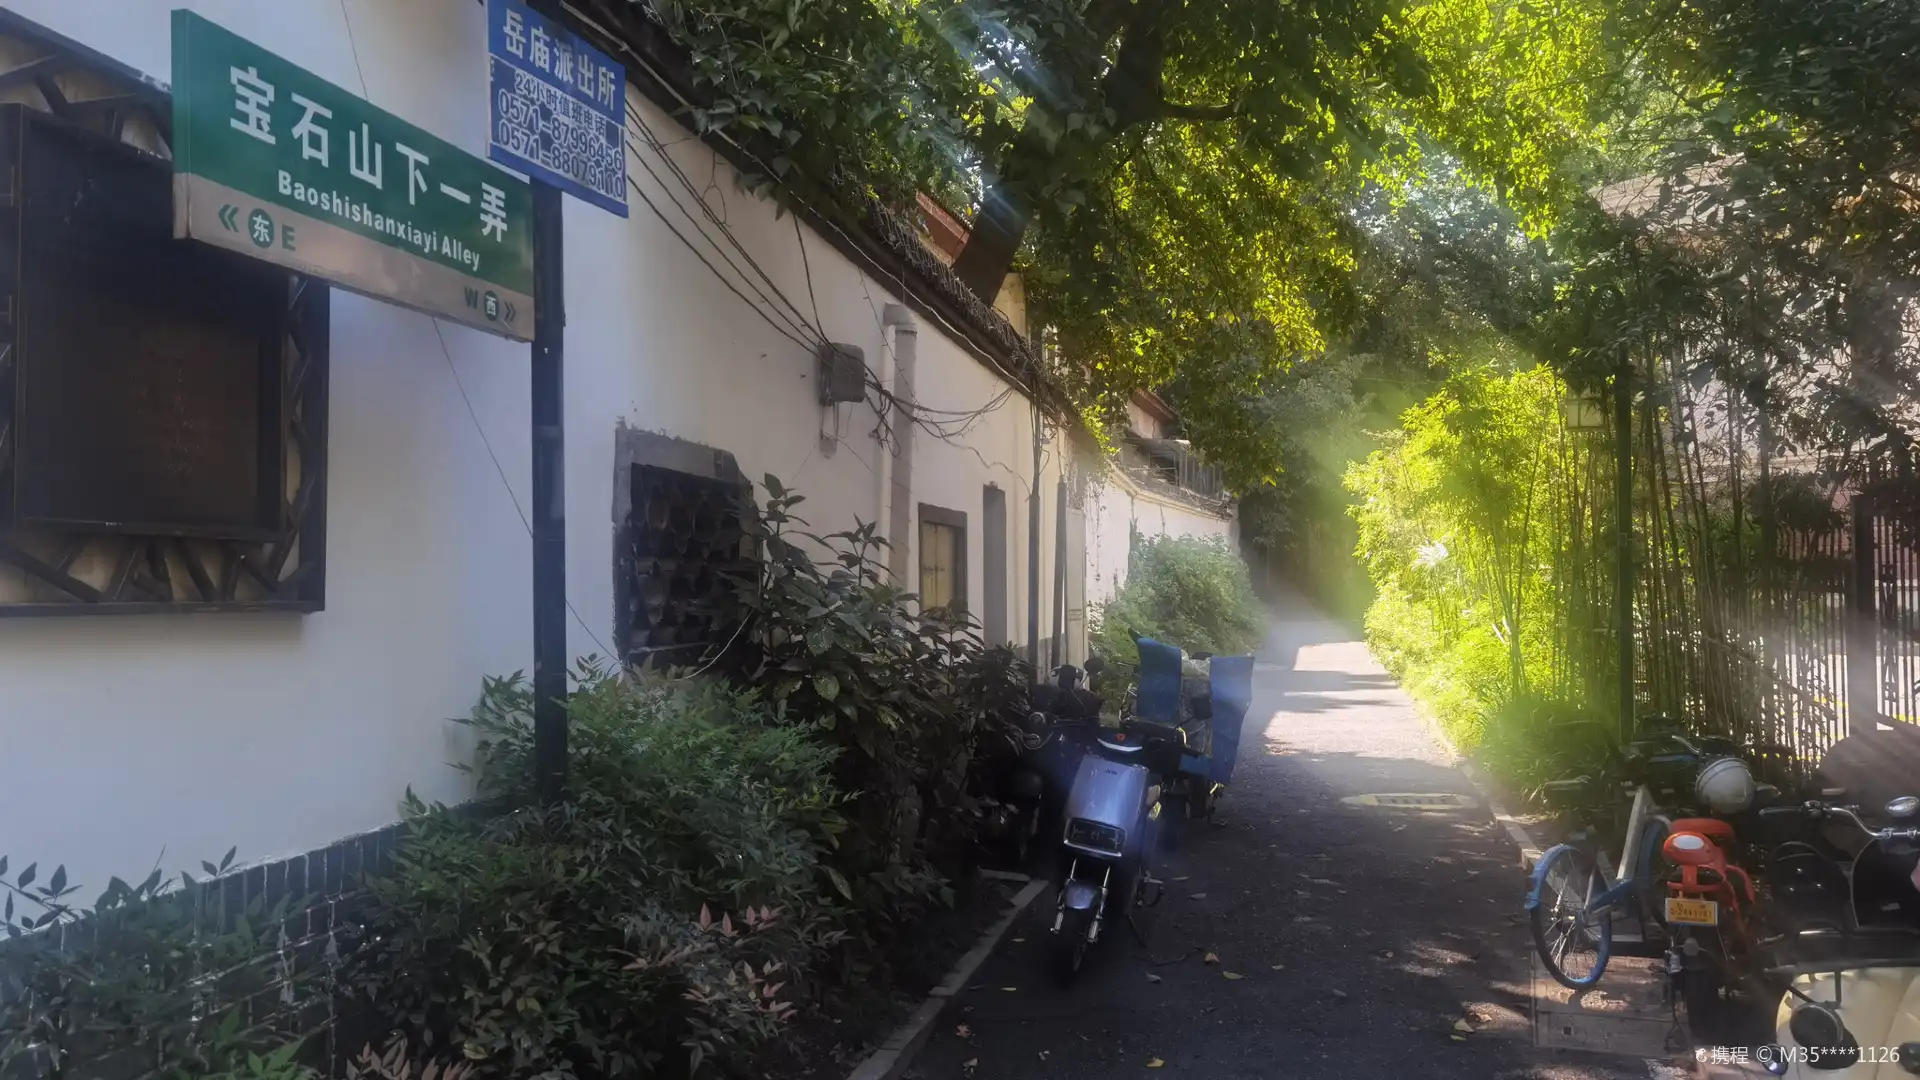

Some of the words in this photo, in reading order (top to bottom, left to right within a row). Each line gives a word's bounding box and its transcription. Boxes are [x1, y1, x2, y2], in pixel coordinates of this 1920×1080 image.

[503, 8, 616, 111] 岳庙派出所
[515, 74, 606, 137] 24小时值班电话
[229, 66, 508, 244] 宝石山下一弄
[252, 214, 271, 243] 东
[281, 225, 296, 251] E
[278, 169, 438, 254] Baoshishanxiayi
[441, 235, 481, 272] Alley
[464, 286, 479, 309] W
[485, 296, 498, 318] 西
